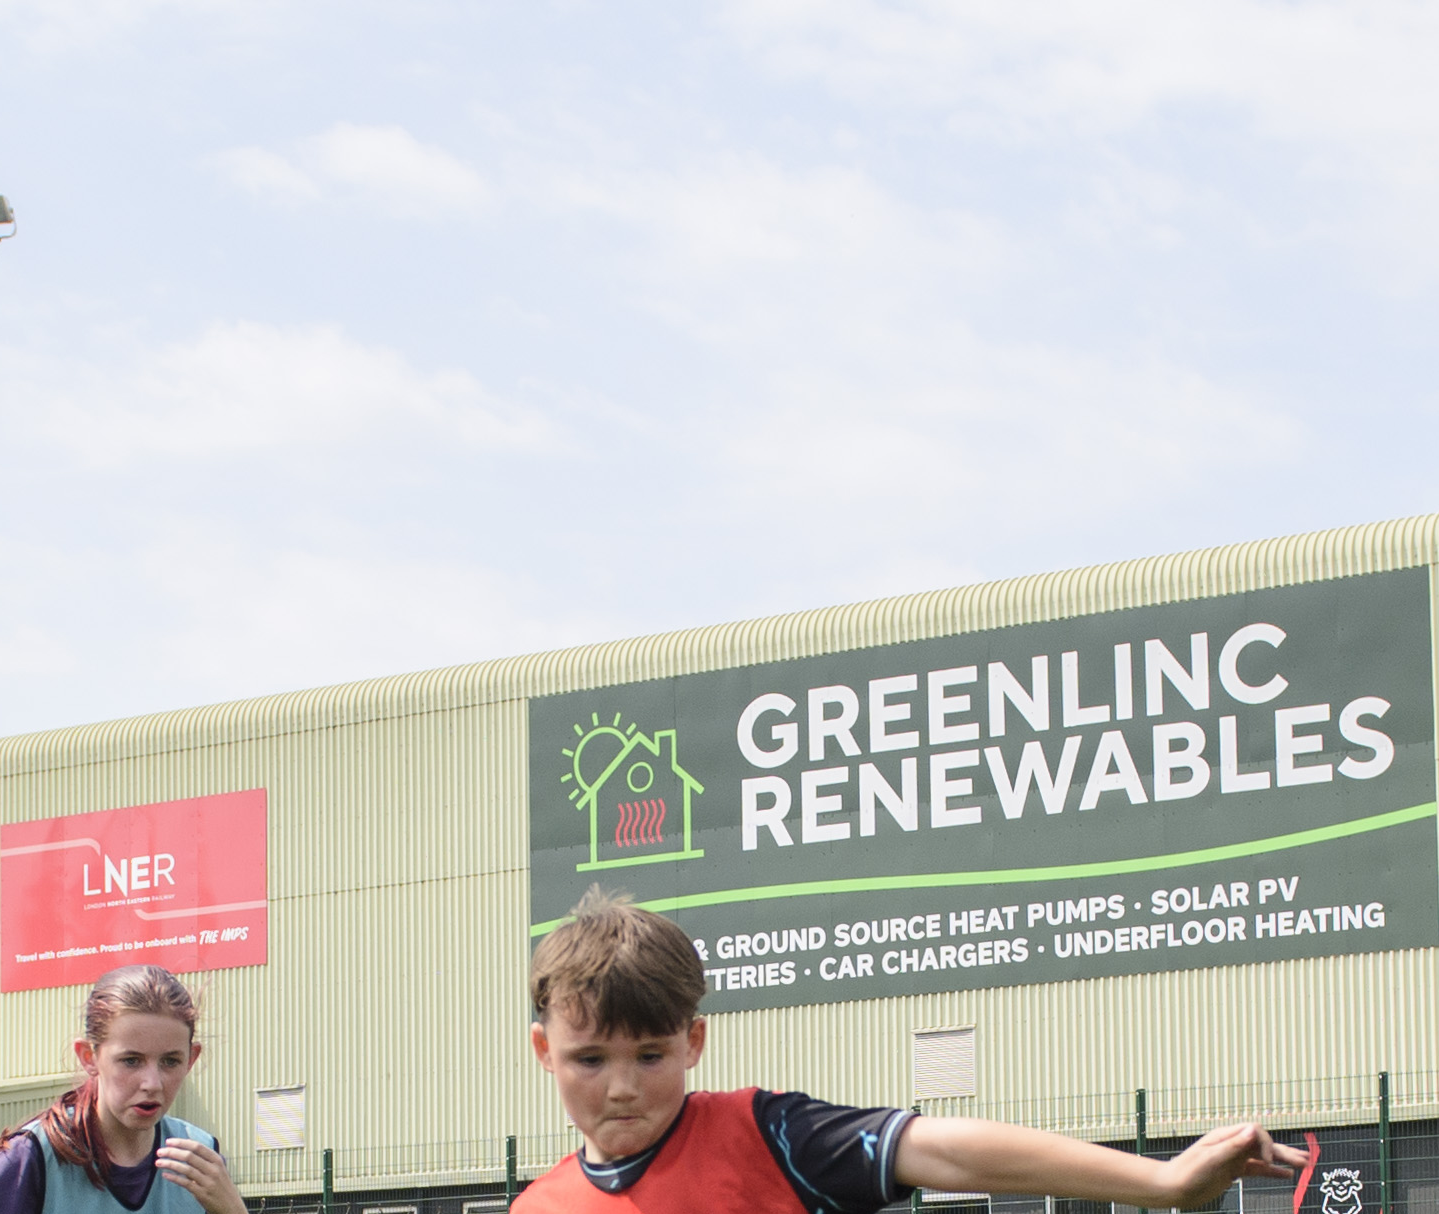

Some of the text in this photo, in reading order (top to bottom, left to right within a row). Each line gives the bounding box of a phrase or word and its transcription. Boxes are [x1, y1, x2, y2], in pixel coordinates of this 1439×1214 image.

[736, 622, 1290, 769] GREENLINC
[741, 695, 1395, 851] RENEWABLES
[83, 853, 175, 898] LNER
[15, 926, 249, 963] Travel with confidence. Proud to be onboard with THE IMPS
[716, 926, 827, 960] GROUND
[834, 913, 942, 947] SOURCE
[949, 905, 1020, 936] HEAT
[1027, 894, 1125, 928] PUMPS
[1151, 881, 1250, 916] SOLAR
[1258, 876, 1300, 905] PV
[819, 953, 874, 981] CAR
[882, 937, 1029, 975] CHARGERS
[1054, 916, 1247, 958] UNDERFLOOR
[1255, 902, 1386, 939] HEATING
